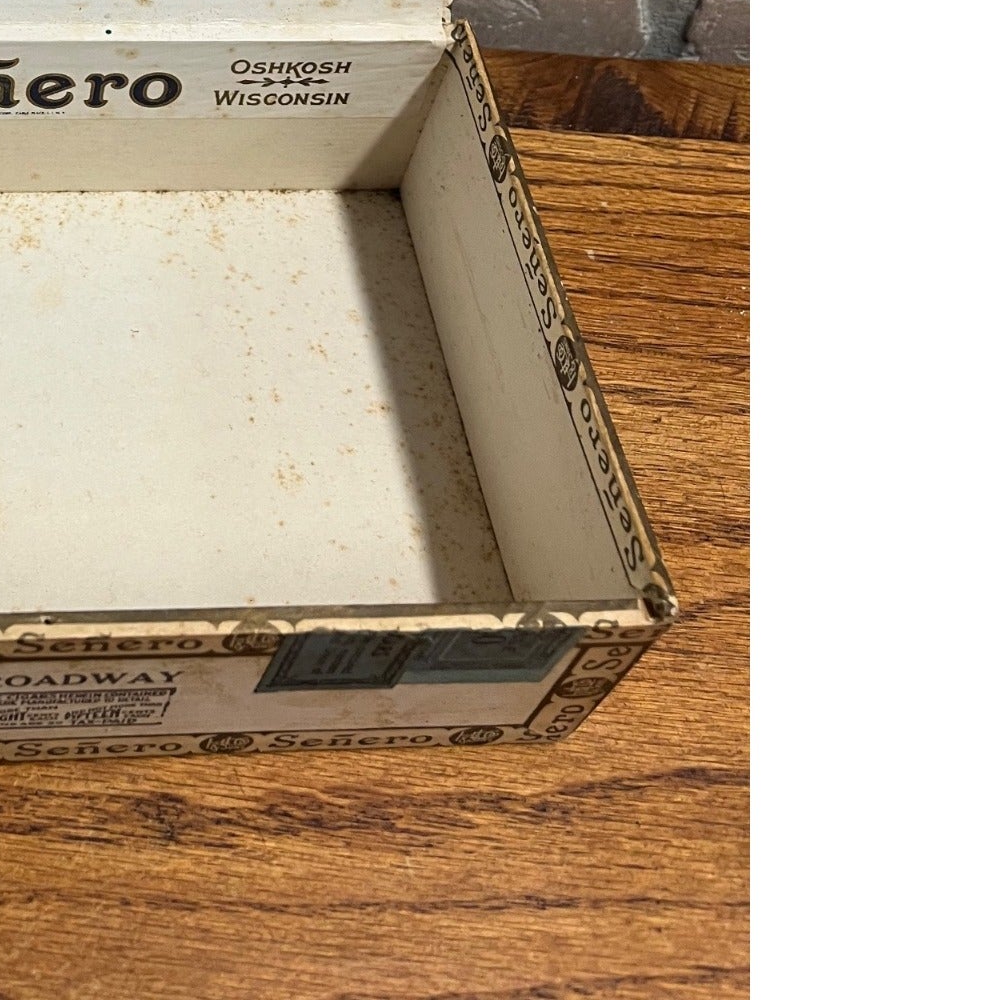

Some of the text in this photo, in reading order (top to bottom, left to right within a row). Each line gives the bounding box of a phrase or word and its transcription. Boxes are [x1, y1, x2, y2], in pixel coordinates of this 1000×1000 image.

[230, 59, 352, 79] OSHKOSH
[213, 90, 351, 106] WISCONSIN
[509, 187, 557, 329] Señero
[581, 398, 644, 571] Señero
[13, 632, 203, 655] Señero
[15, 739, 183, 757] Señero
[269, 732, 433, 749] Señero
